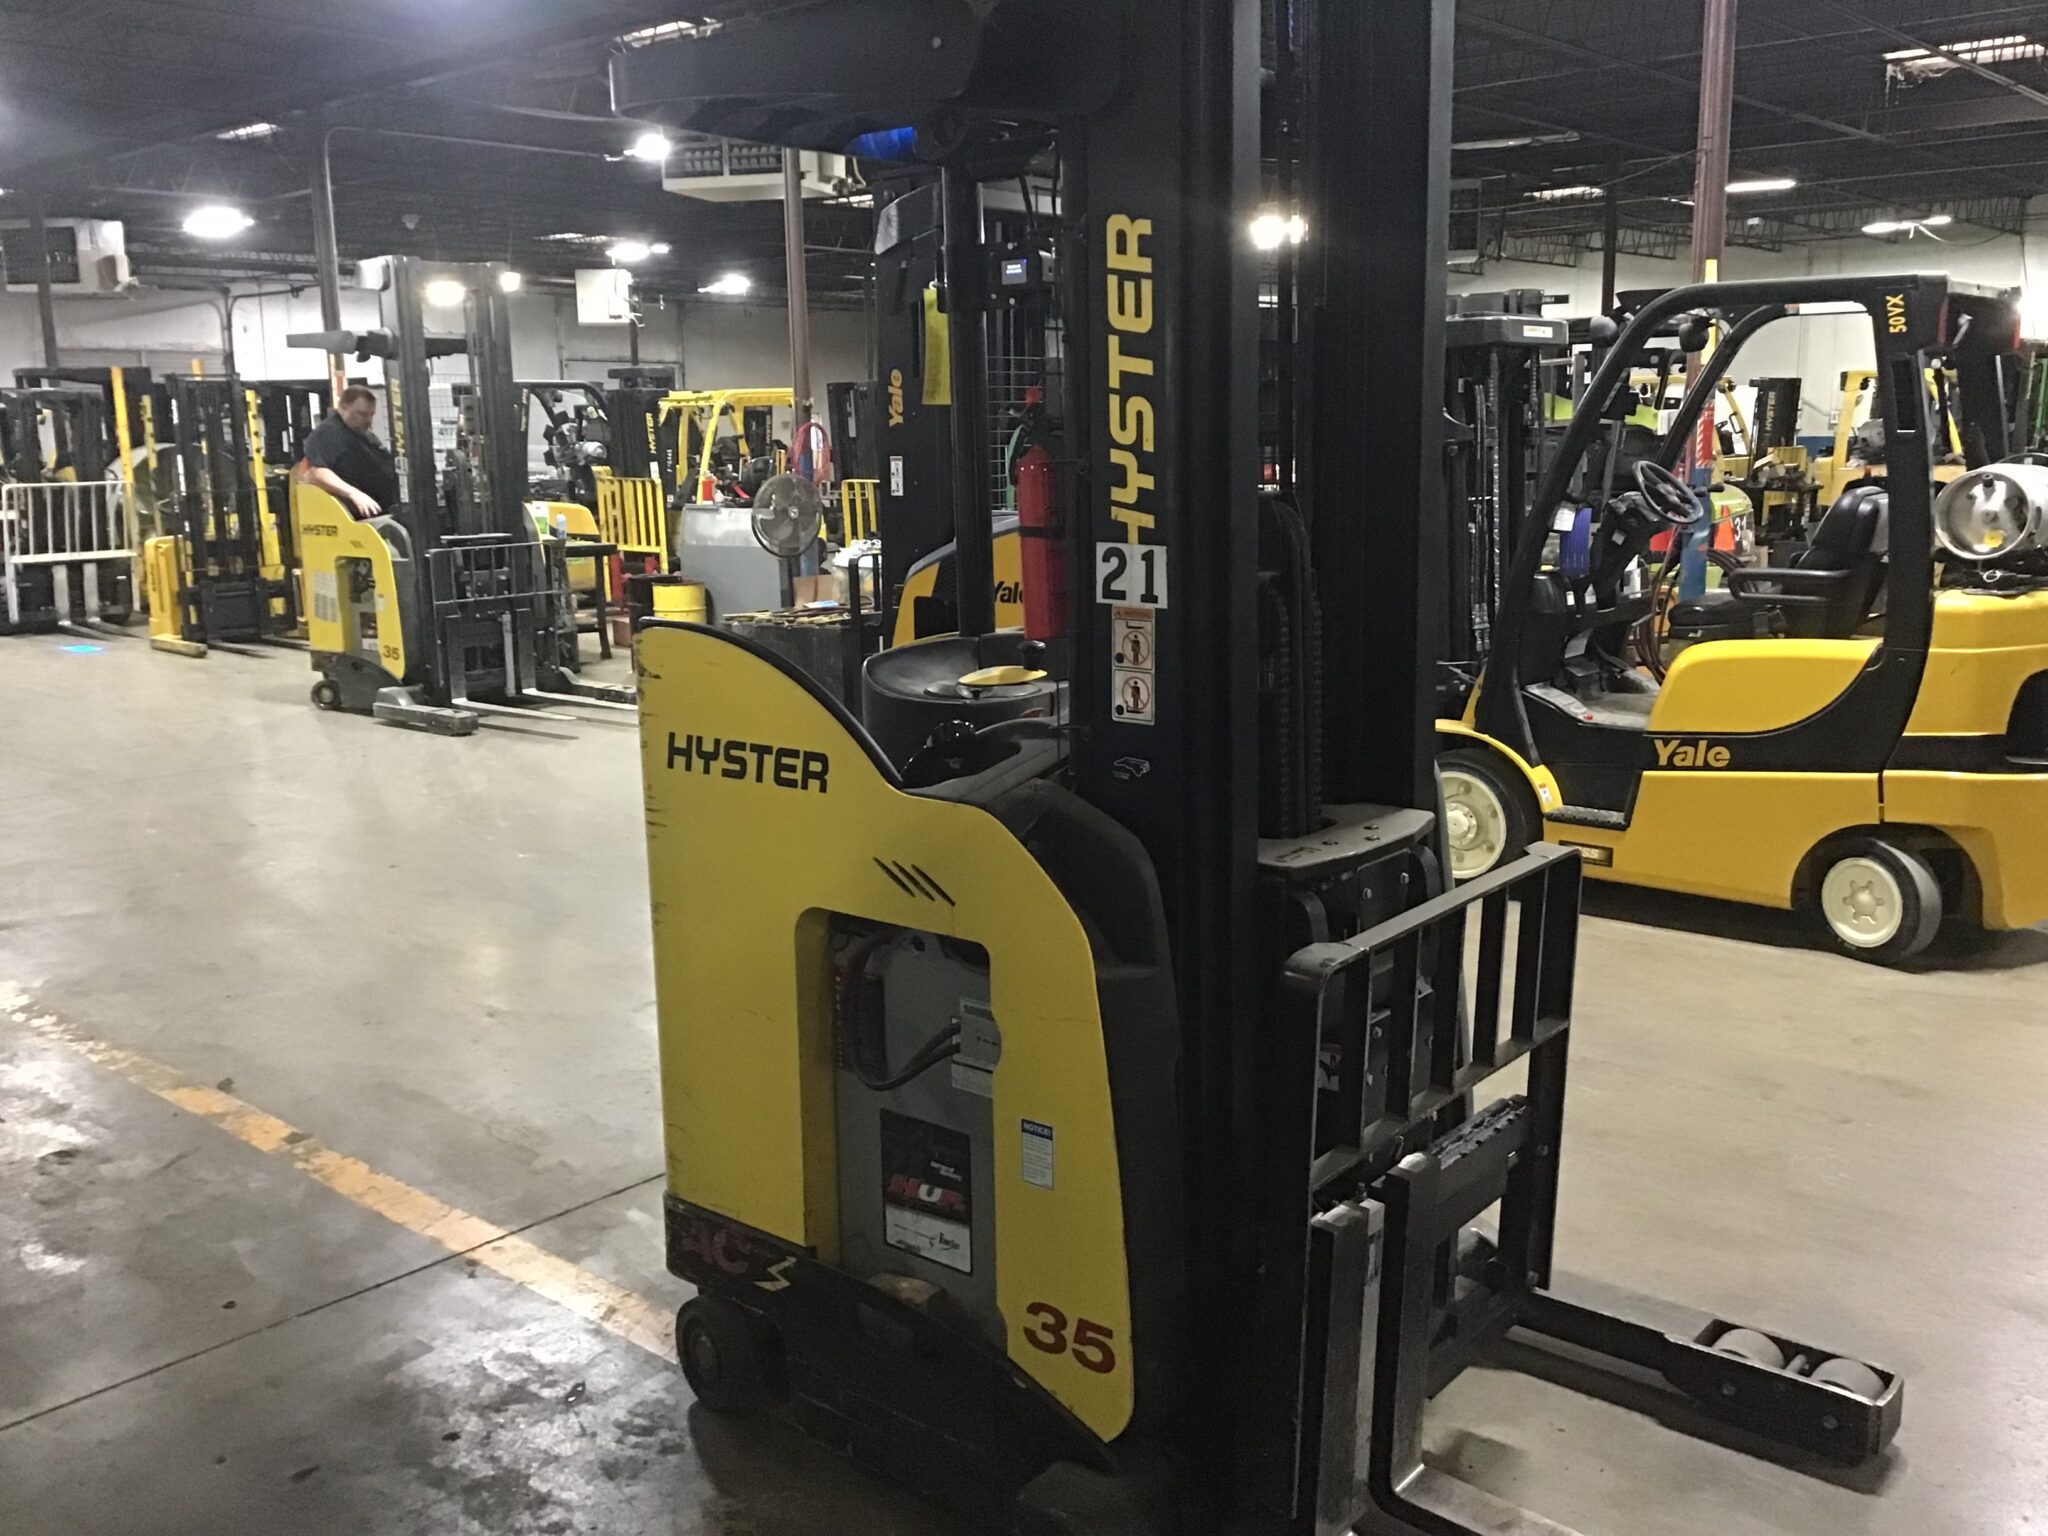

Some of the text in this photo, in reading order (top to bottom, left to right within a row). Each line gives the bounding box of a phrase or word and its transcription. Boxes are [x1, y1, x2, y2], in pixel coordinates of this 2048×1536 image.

[1885, 293, 1908, 335] 50VX
[888, 368, 904, 428] Yale
[1105, 213, 1155, 545] HYSTER
[1764, 391, 1776, 431] HYSTER
[646, 412, 657, 455] HYSTER
[302, 523, 338, 537] HYSTER
[1101, 546, 1159, 604] 21
[382, 644, 401, 661] 35
[667, 731, 830, 793] HYSTER
[1653, 738, 1731, 768] Yale
[1022, 1300, 1117, 1375] 35
